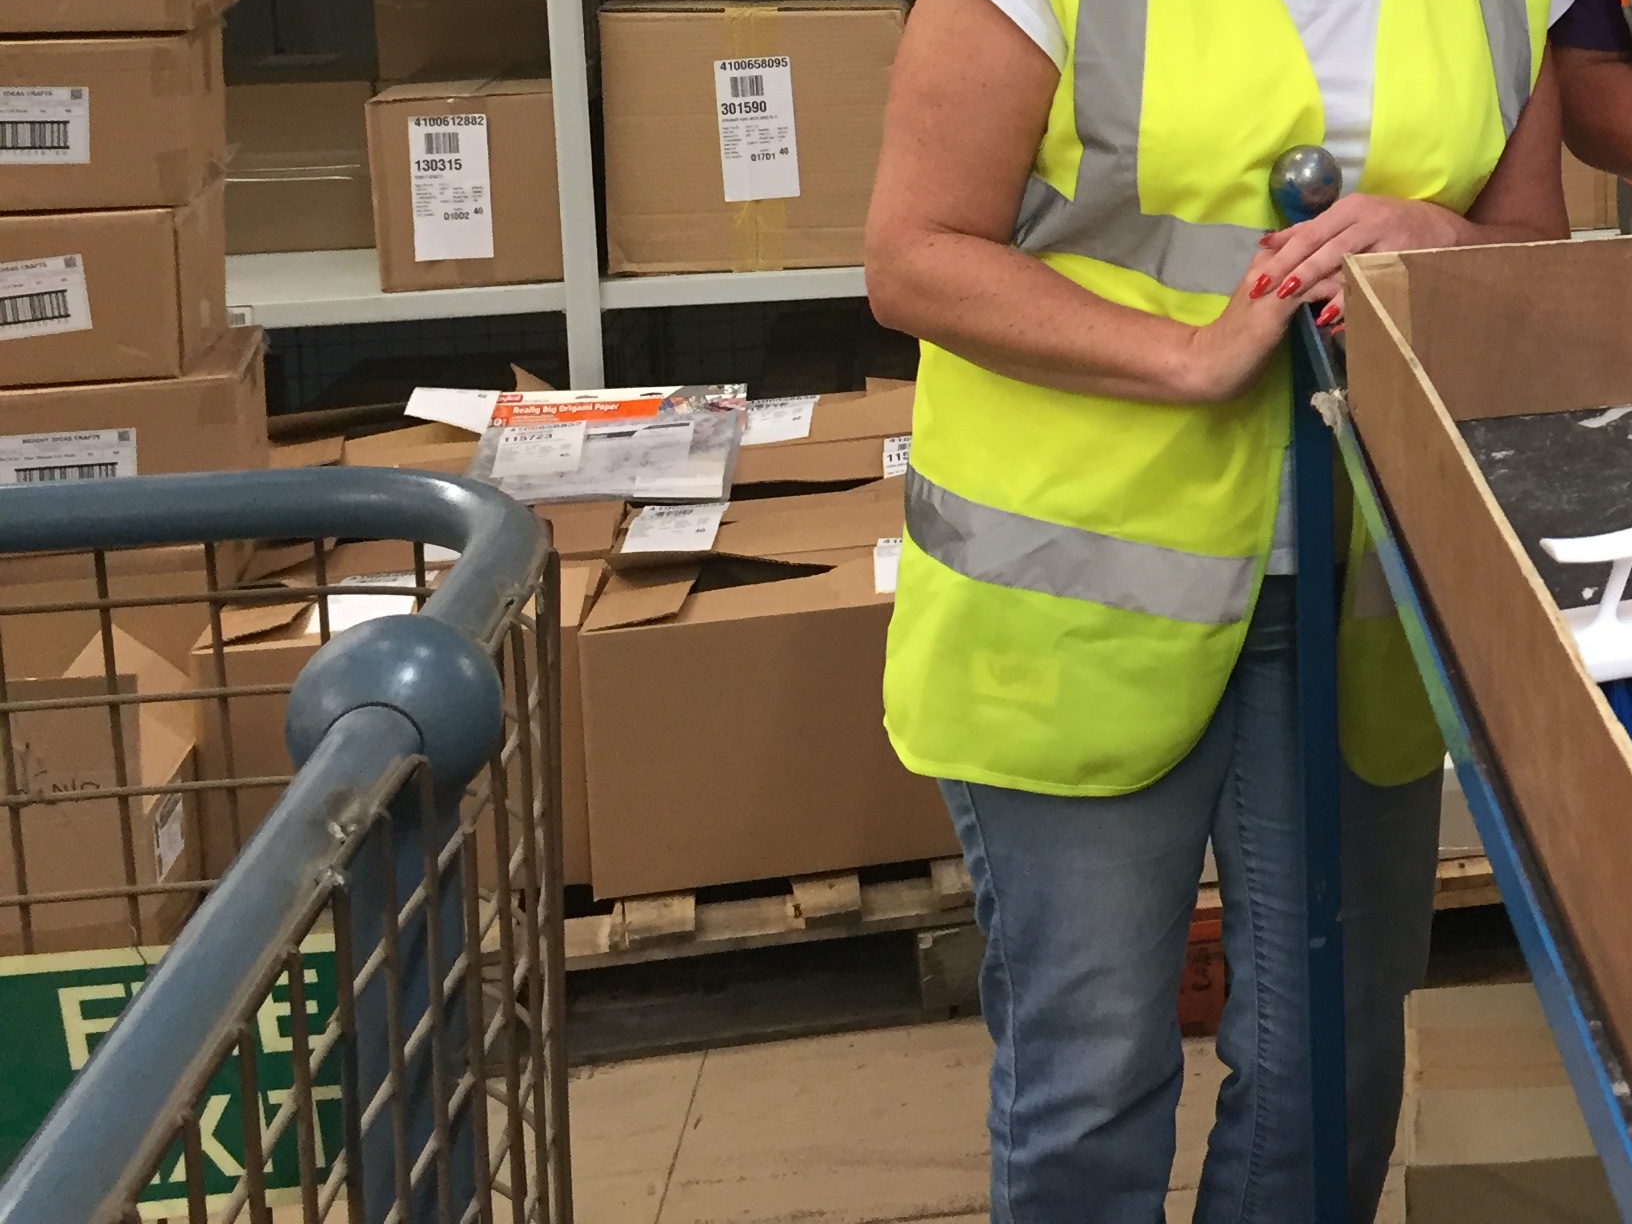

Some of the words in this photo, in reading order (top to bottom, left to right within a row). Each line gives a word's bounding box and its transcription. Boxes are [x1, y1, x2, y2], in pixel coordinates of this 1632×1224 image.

[720, 57, 788, 71] 4100658095
[721, 100, 767, 115] 301590
[414, 116, 484, 127] 4100612882
[415, 159, 462, 172] 130315
[513, 405, 540, 415] Really
[542, 405, 557, 413] Big
[559, 404, 593, 414] Origami
[594, 403, 620, 412] Paper
